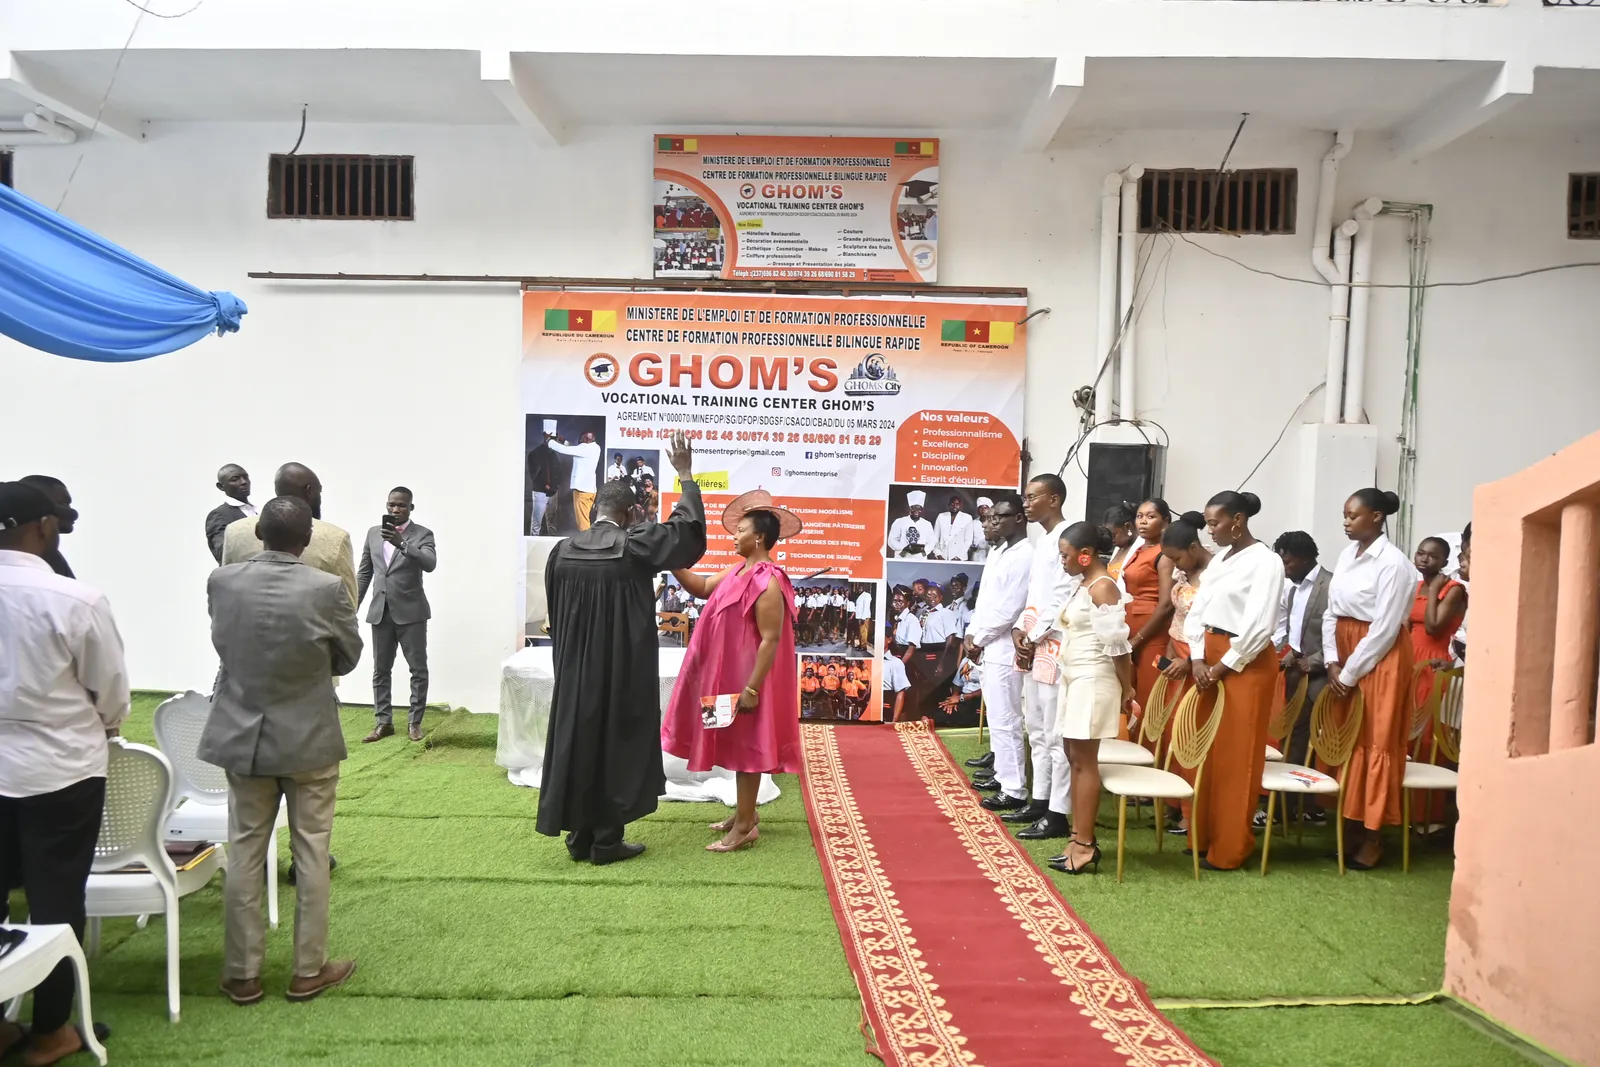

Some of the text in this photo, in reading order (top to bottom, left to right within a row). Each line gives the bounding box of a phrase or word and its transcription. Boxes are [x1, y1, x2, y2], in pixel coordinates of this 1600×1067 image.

[703, 156, 890, 167] MINISTERE DE L'EMPLOI ET DE FORMATION PROFESSIONNELLE
[702, 170, 887, 181] CENTRE DE FORMATION PROFESSIONNELLE BILINGUE RAPIDE
[761, 184, 843, 199] GHOM'S
[736, 201, 777, 210] VOCATIONAL
[779, 202, 810, 210] TRAINING
[839, 203, 864, 211] GHOM'S
[626, 306, 926, 328] MINISTERE DE L'EMPLOI ET DE FORMATION PROFESSIONNELLE
[626, 329, 920, 350] CENTRE DE FORMATION PROFESSIONNELLE BILINGUE RAPIDE
[844, 380, 901, 392] GHOMS City
[601, 392, 687, 406] VOCATIONAL
[692, 395, 758, 408] TRAINING
[763, 398, 817, 410] CENTER
[617, 411, 658, 422] AGREMENT
[846, 418, 855, 428] 05
[857, 419, 878, 429] MARS
[879, 420, 895, 429] 2024
[920, 412, 989, 424] Nos valeurs
[705, 429, 718, 441] 82
[720, 430, 734, 441] 46
[736, 431, 769, 442] 30/674
[772, 431, 785, 442] 39
[787, 432, 800, 443] 26
[802, 433, 836, 445] 68/690
[838, 434, 850, 445] 81
[853, 435, 866, 446] 58
[868, 435, 882, 446] 29
[922, 428, 1003, 438] Professionnalisme
[922, 440, 969, 449] Excellence
[688, 447, 877, 461] homesentreprise@gmail.com ghom'sentreprise
[921, 452, 965, 461] Discipline
[921, 463, 968, 472] Innovation
[784, 469, 838, 478] @ghomsentreprise
[920, 475, 987, 485] Esprit d'équipe
